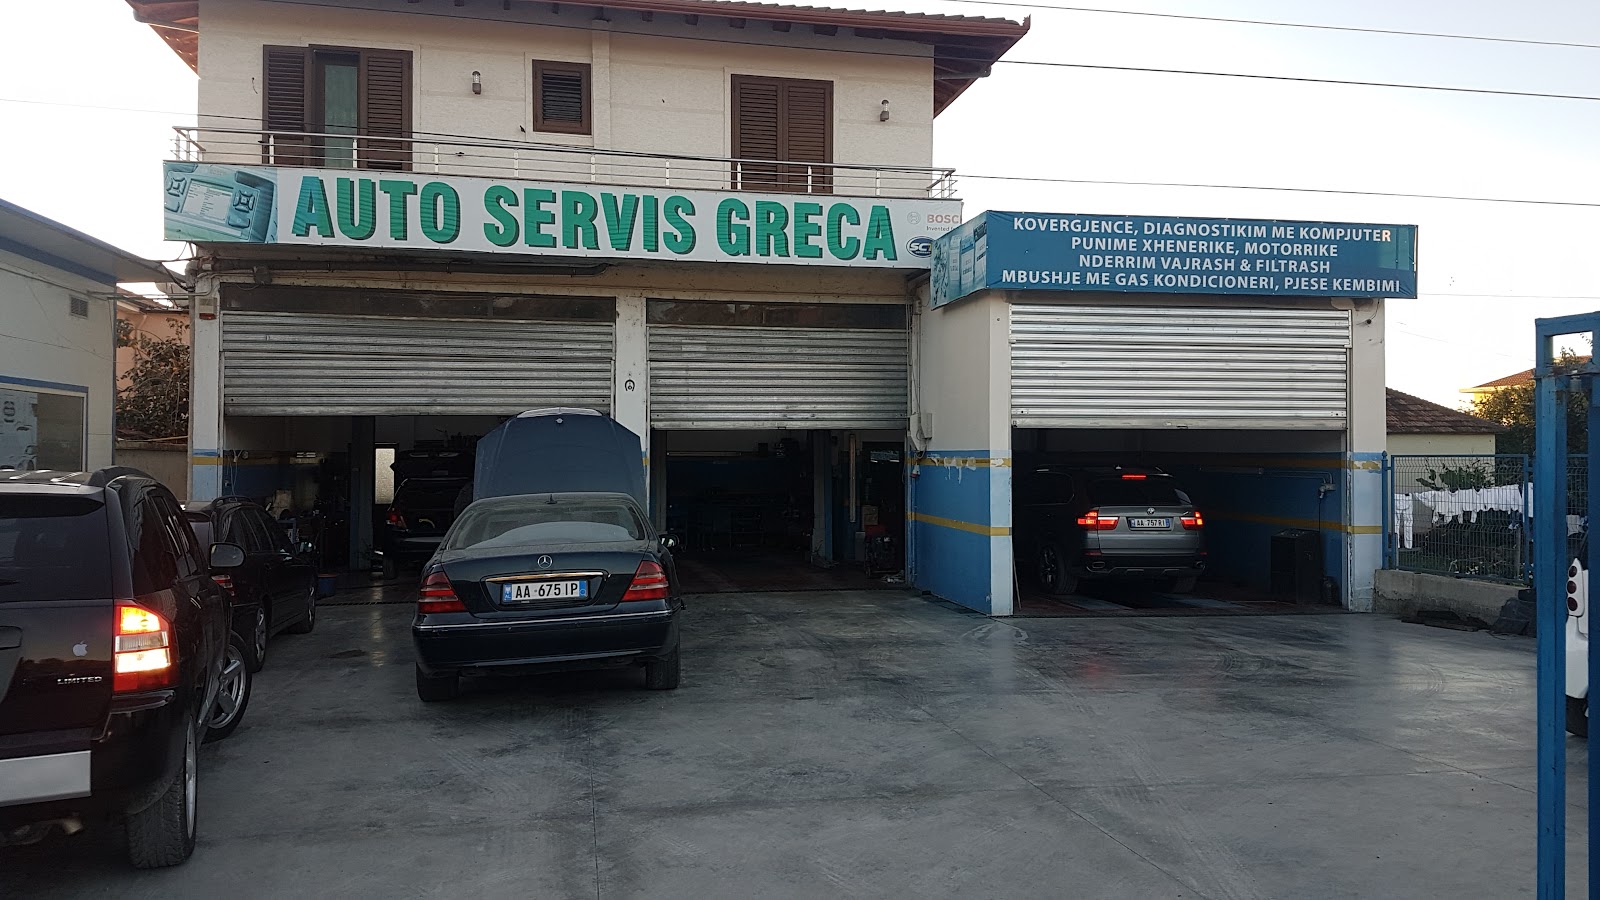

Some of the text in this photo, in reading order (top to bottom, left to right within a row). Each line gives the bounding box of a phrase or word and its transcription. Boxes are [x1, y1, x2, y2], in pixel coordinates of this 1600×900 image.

[292, 176, 460, 244] AUTO
[483, 184, 697, 255] SERVIS
[716, 197, 898, 261] GRECA
[1013, 217, 1391, 242] KOVERGJENCE, DIAGNOSTIKIM ME KOMPJUTER
[1071, 237, 1338, 257] PUNIME XHENERIKE, MOTORRIKE
[1079, 254, 1330, 273] NDERRIM VAJRASH & FILTRASH
[1002, 270, 1400, 292] MBUSHJE ME GAS KONDICIONERI, PJESE KEMBIMI
[1136, 519, 1144, 527] AA
[515, 582, 578, 598] AA 675 IP
[57, 676, 103, 685] LIMITED
